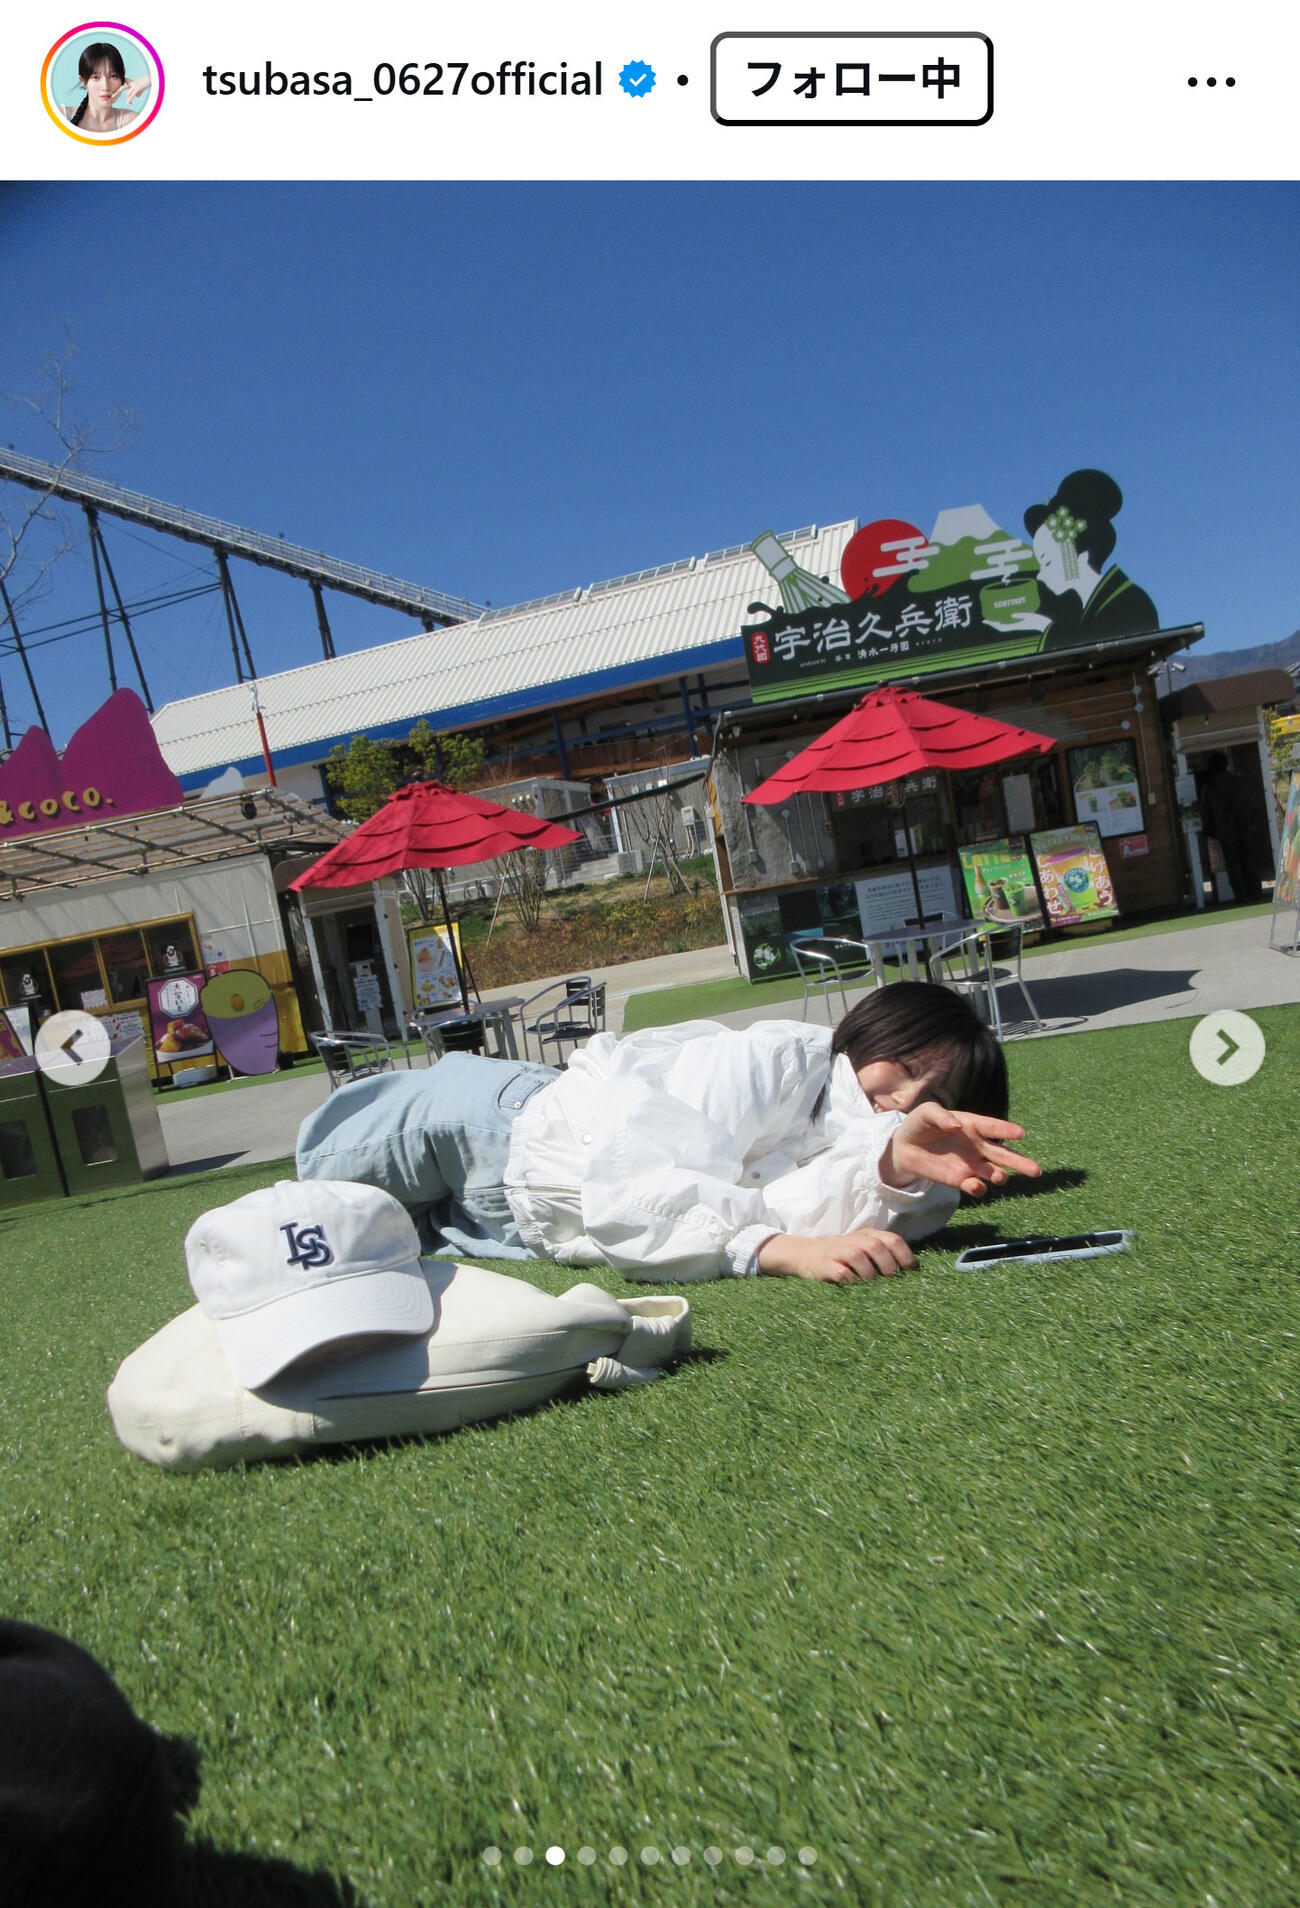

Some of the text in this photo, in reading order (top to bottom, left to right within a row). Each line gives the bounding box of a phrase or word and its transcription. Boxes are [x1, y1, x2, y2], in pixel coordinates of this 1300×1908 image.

[773, 595, 973, 661] 宇治久兵衛
[280, 1222, 335, 1270] LS
